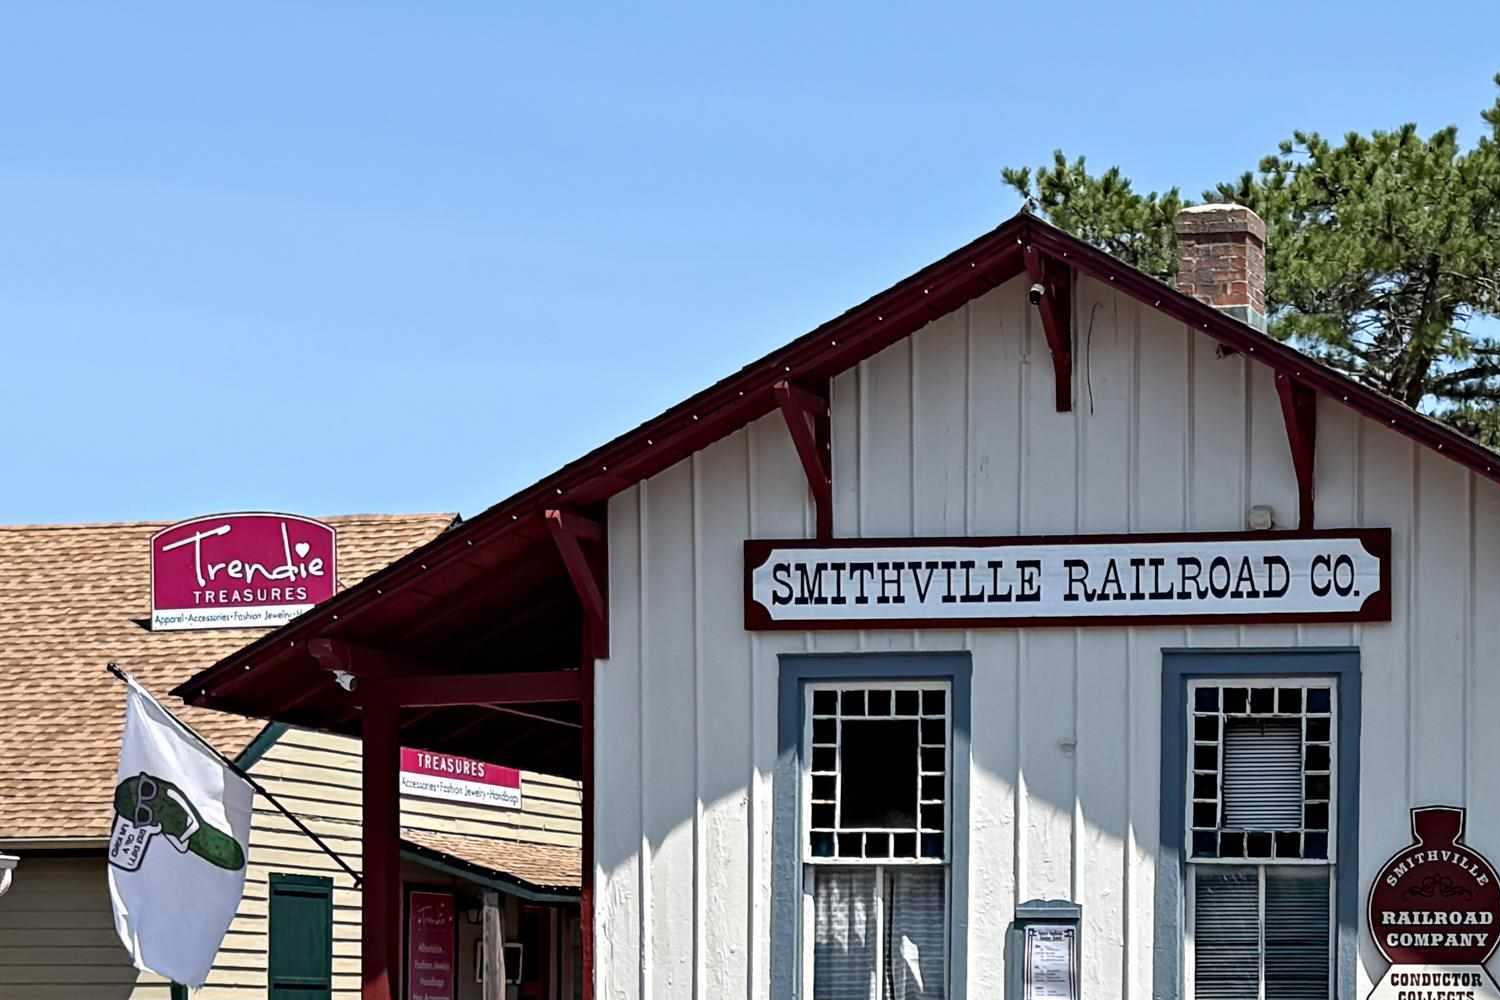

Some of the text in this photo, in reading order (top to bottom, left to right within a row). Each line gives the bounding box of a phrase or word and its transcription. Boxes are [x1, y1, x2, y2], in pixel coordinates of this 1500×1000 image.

[162, 522, 325, 588] Trendie
[771, 553, 1361, 606] SMITHVILLE RAILROAD CO.
[193, 587, 307, 605] TREASURES
[417, 753, 485, 778] TREASURES
[1386, 850, 1490, 887] SMITHVILLE
[1382, 911, 1493, 925] RAILROAD
[1386, 933, 1489, 947] COMPANY
[1390, 973, 1483, 987] CONDUCTOR
